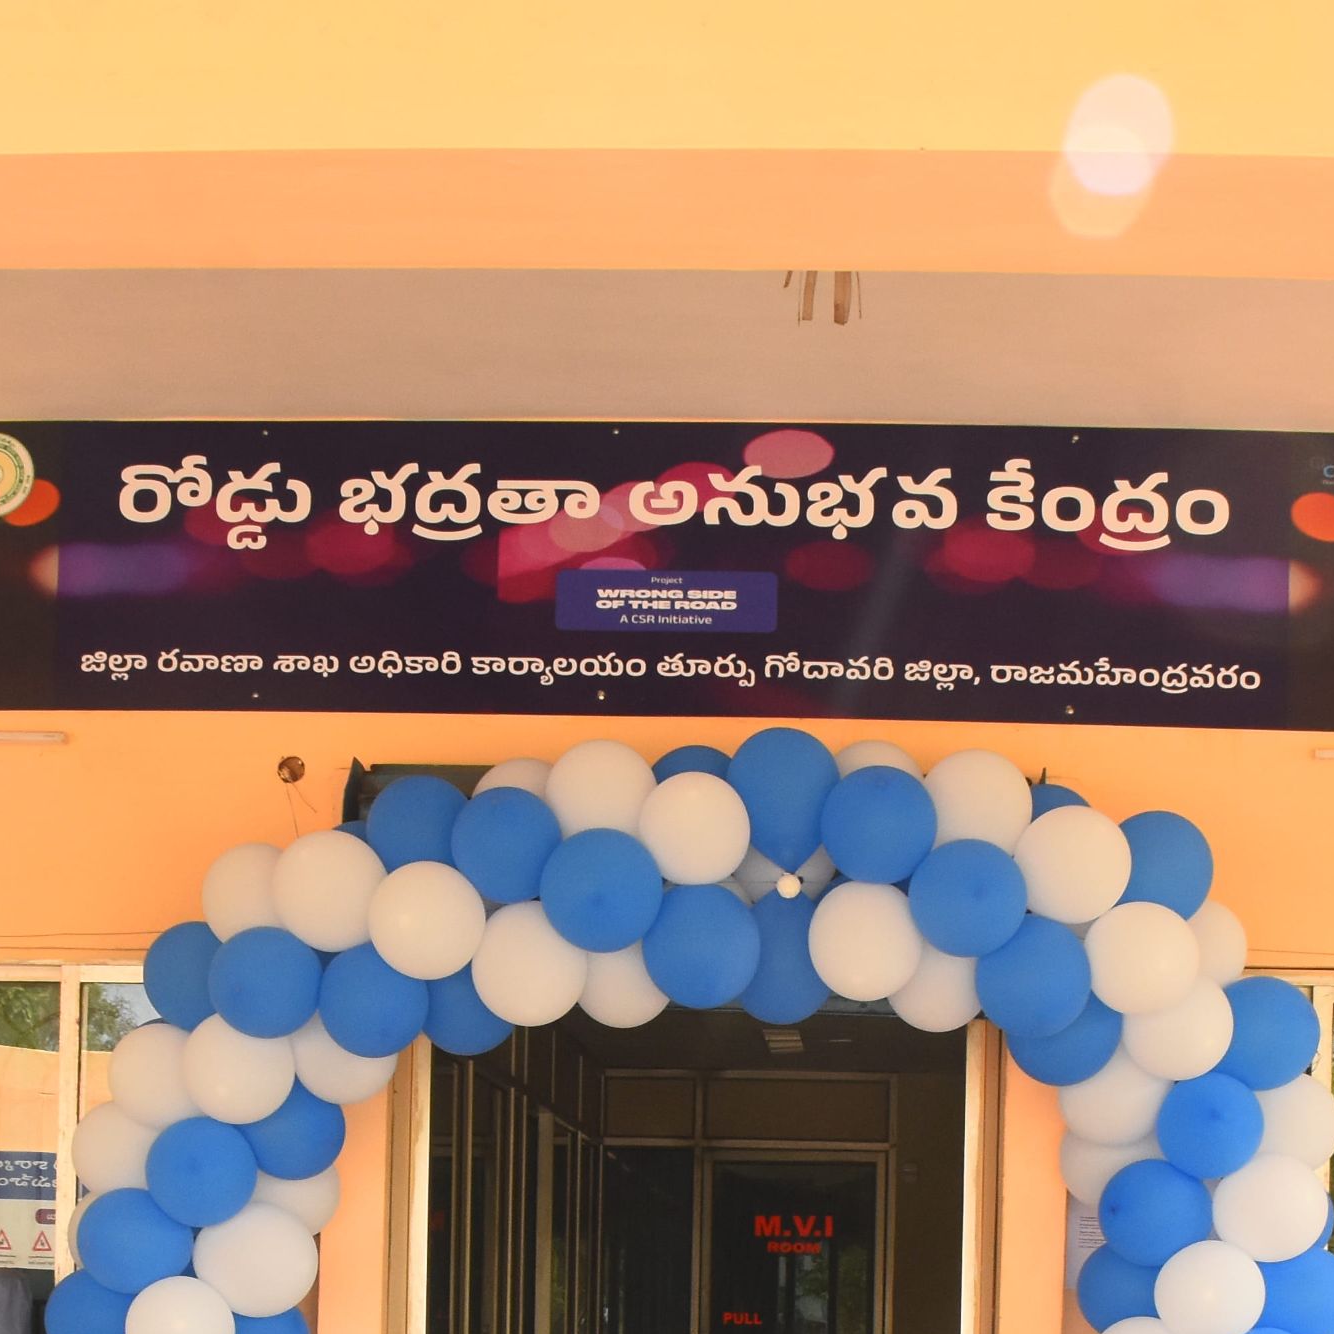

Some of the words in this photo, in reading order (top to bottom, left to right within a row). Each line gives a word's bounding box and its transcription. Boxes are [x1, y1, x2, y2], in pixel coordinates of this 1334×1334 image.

[119, 455, 312, 549] రోడ్డు
[338, 462, 602, 541] భద్రతా
[629, 465, 958, 539] అనుభవ
[986, 458, 1230, 552] కేంద్రం
[651, 576, 683, 585] Project
[597, 588, 684, 599] WRONG
[687, 589, 737, 600] SIDE
[596, 600, 625, 609] OF
[628, 600, 671, 610] THE
[674, 601, 738, 610] ROAD
[619, 614, 629, 624] A
[631, 614, 656, 624] CSR
[658, 614, 713, 625] Initiative
[80, 650, 148, 681] జిల్లా
[157, 648, 264, 673] రవాణా
[273, 652, 340, 678] శాఖ
[349, 650, 462, 679] అధికారి
[471, 651, 647, 686] కార్యాలయం
[656, 652, 755, 687] తూర్పు
[763, 652, 895, 682] గోదావరి
[904, 659, 980, 691] జిల్లా,
[989, 656, 1262, 695] రాజమహేంద్రవరం
[754, 1215, 834, 1238] M.V.I
[767, 1242, 822, 1254] ROOM
[722, 1311, 763, 1325] PULL
